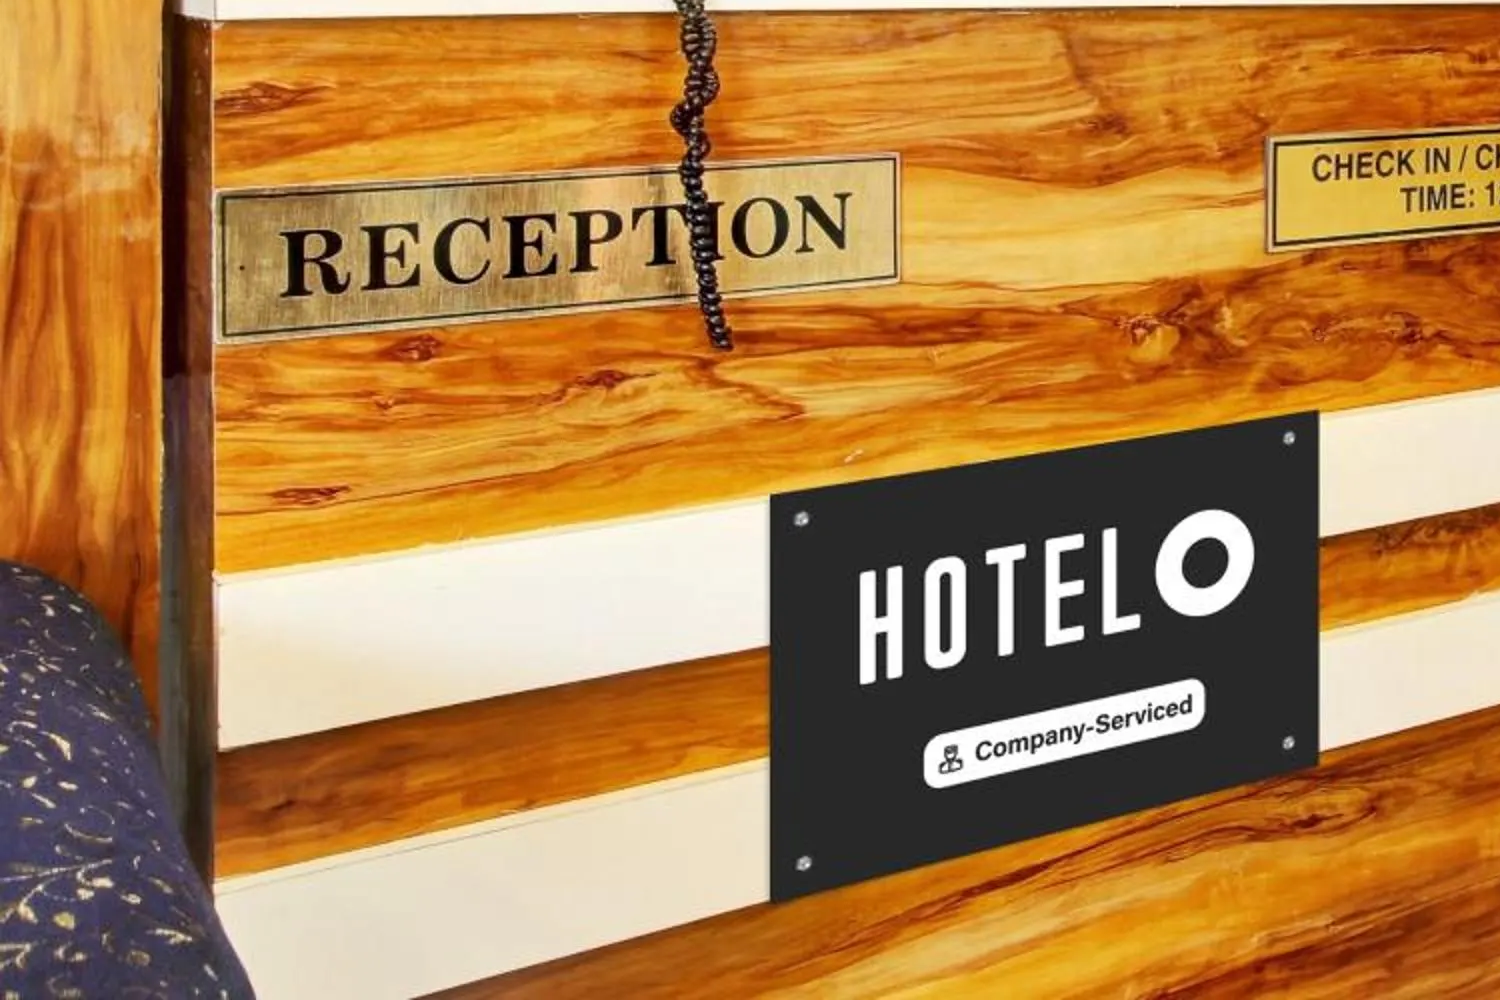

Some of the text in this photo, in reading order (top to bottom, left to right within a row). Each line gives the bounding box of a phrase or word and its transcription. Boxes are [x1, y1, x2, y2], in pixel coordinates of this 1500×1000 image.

[1311, 149, 1416, 183] CHECK
[1425, 146, 1452, 174] IN
[1400, 182, 1475, 214] TIME:
[859, 527, 1141, 686] HOTEL
[974, 693, 1194, 763] Company-Serviced
